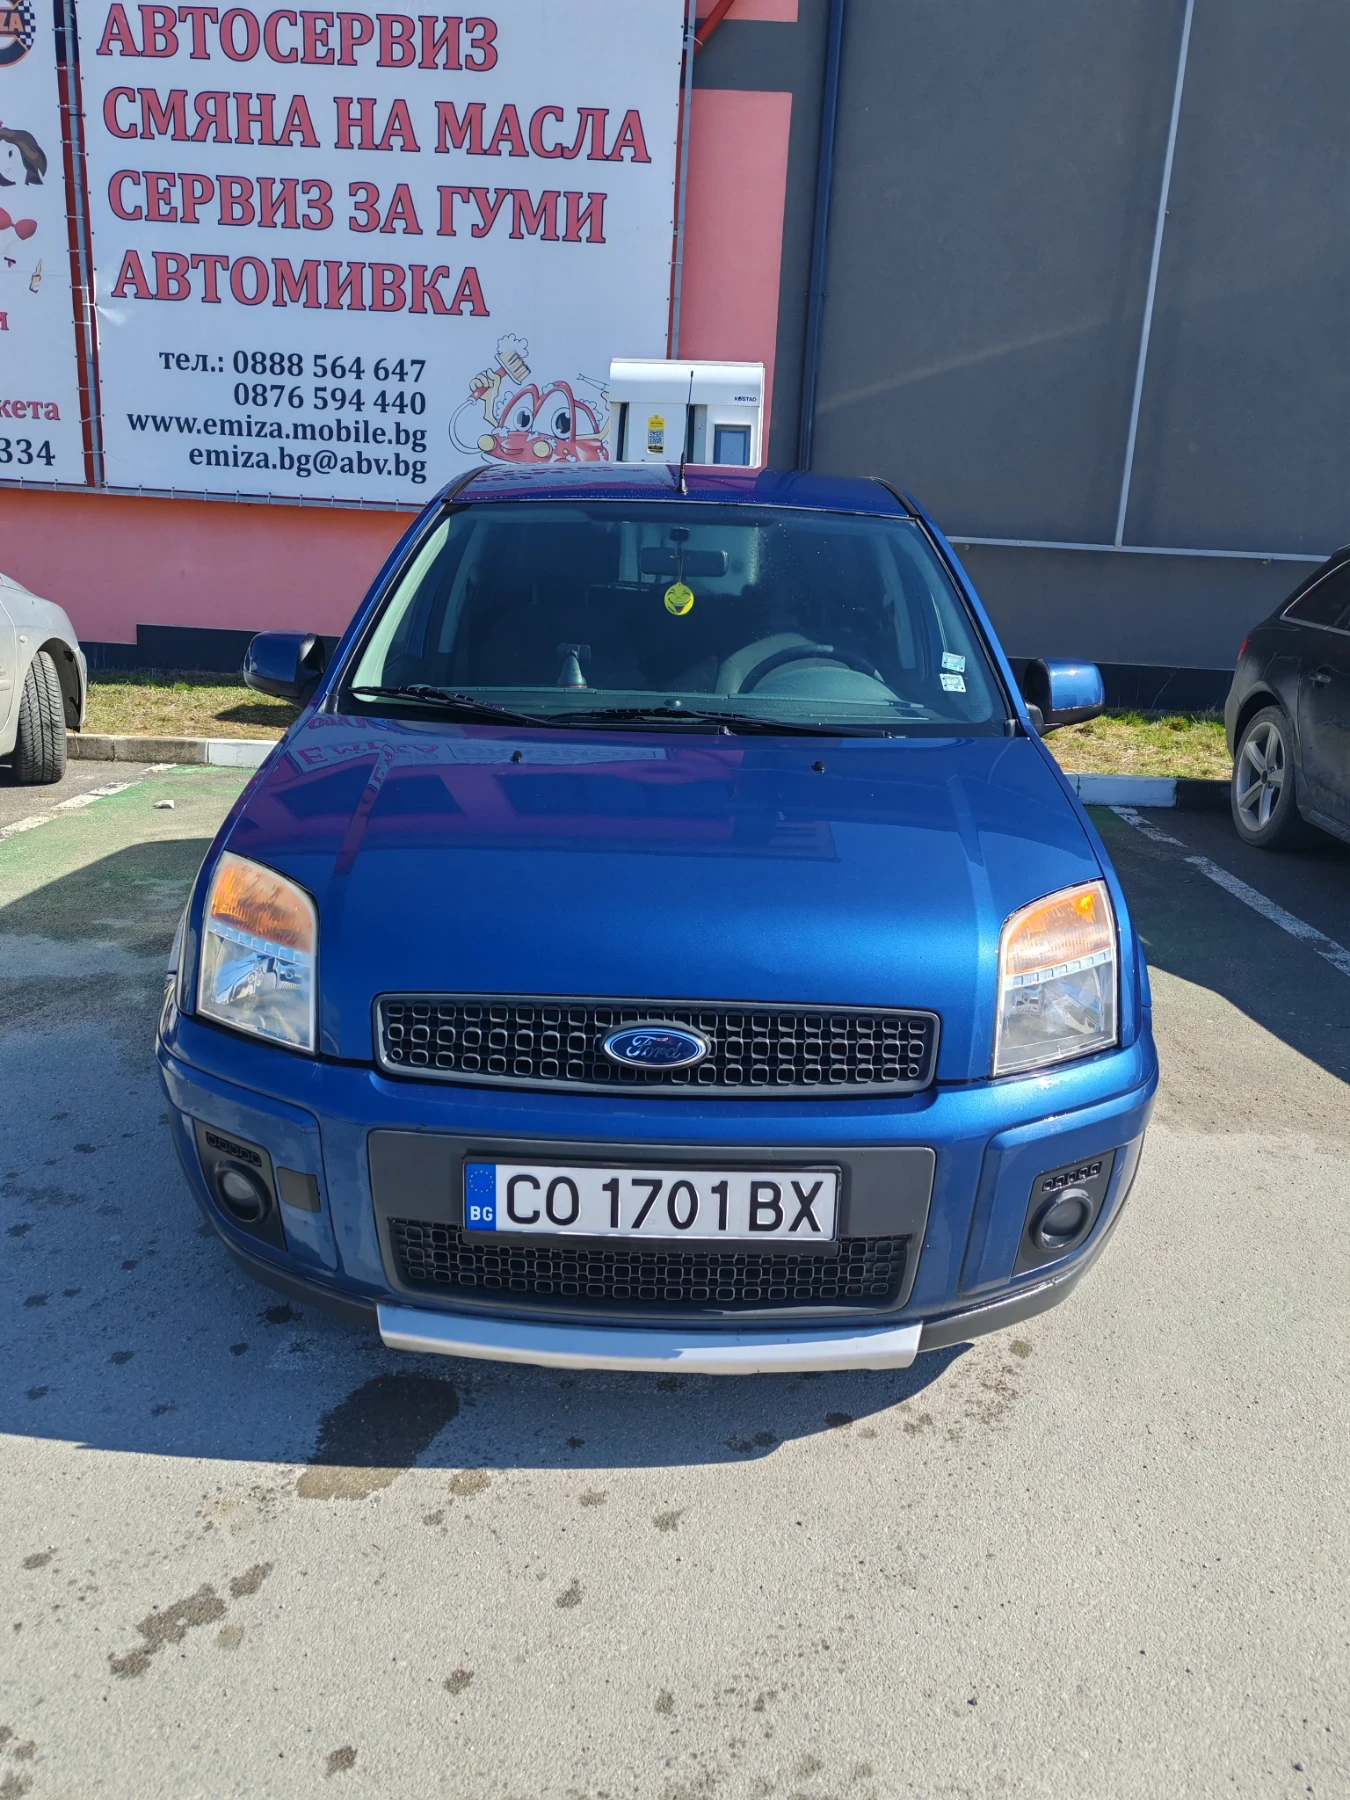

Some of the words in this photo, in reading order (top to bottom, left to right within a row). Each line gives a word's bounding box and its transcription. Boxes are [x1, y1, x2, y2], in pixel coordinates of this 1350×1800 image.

[96, 3, 499, 72] АВТОСЕРВИЗ
[103, 86, 321, 148] СМЯНА
[333, 96, 421, 153] НА
[434, 101, 652, 164] МАСЛА
[108, 169, 334, 231] СЕРВИЗ
[348, 181, 424, 236] ЗА
[436, 186, 608, 244] ГУМИ
[110, 249, 491, 317] АВТОМИВКА
[159, 352, 224, 373] тел.:
[233, 350, 304, 377] 0888
[313, 354, 366, 380] 564
[373, 358, 426, 383] 647
[233, 382, 304, 409] 0876
[313, 386, 366, 412] 594
[373, 389, 426, 416] 440
[126, 412, 428, 453] www.emiza.mobile.bg
[188, 445, 428, 484] emiza.bg@abv.bg
[626, 1035, 683, 1059] Ford
[470, 1205, 493, 1221] BG
[506, 1174, 580, 1226] CO
[602, 1177, 729, 1231] 1701
[748, 1180, 824, 1233] BX
